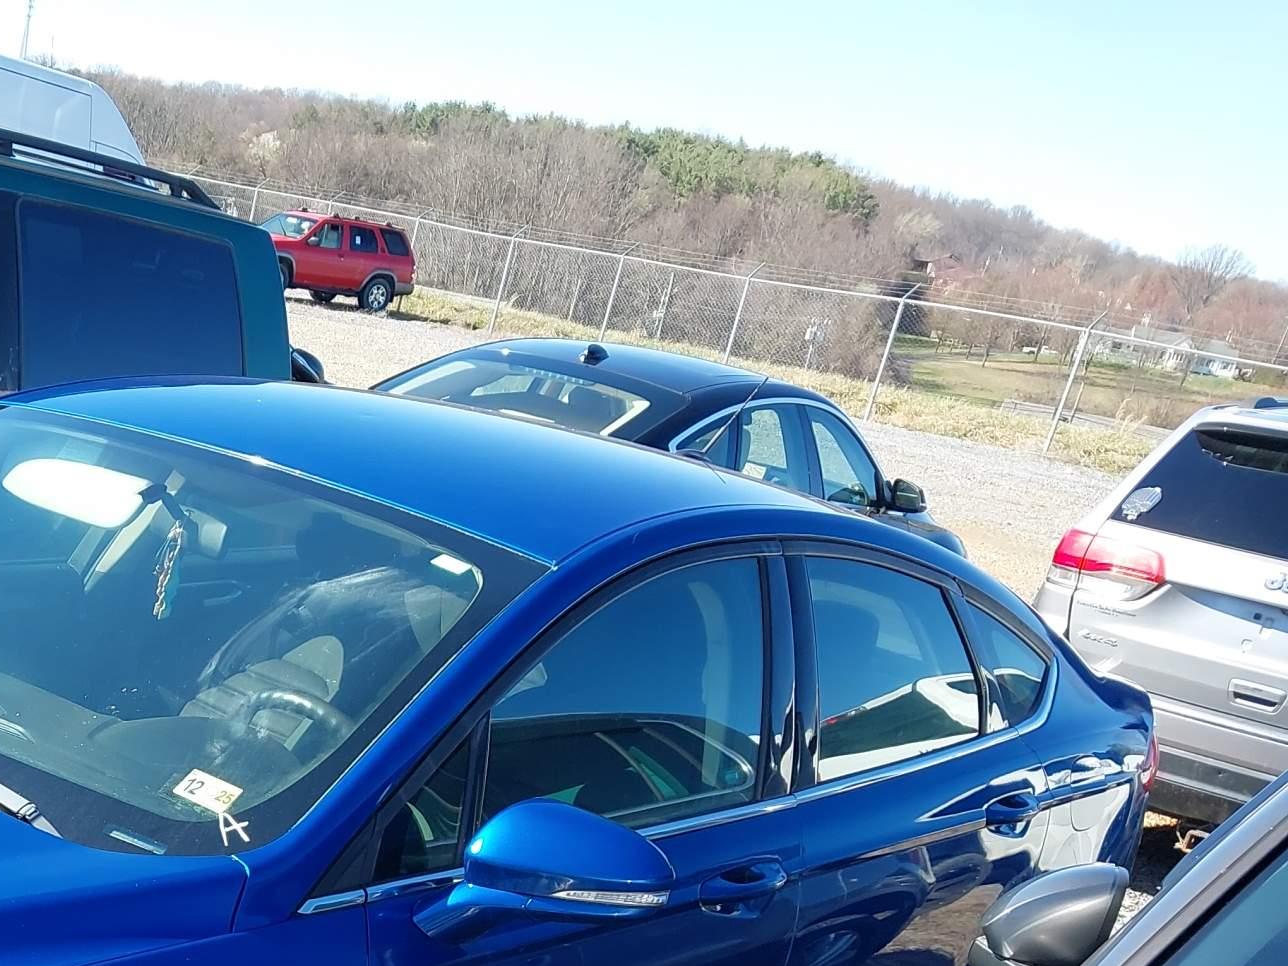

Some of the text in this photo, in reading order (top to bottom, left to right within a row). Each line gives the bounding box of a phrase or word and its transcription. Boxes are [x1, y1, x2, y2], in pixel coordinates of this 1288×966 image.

[183, 778, 235, 805] 12 25
[218, 812, 251, 847] A
